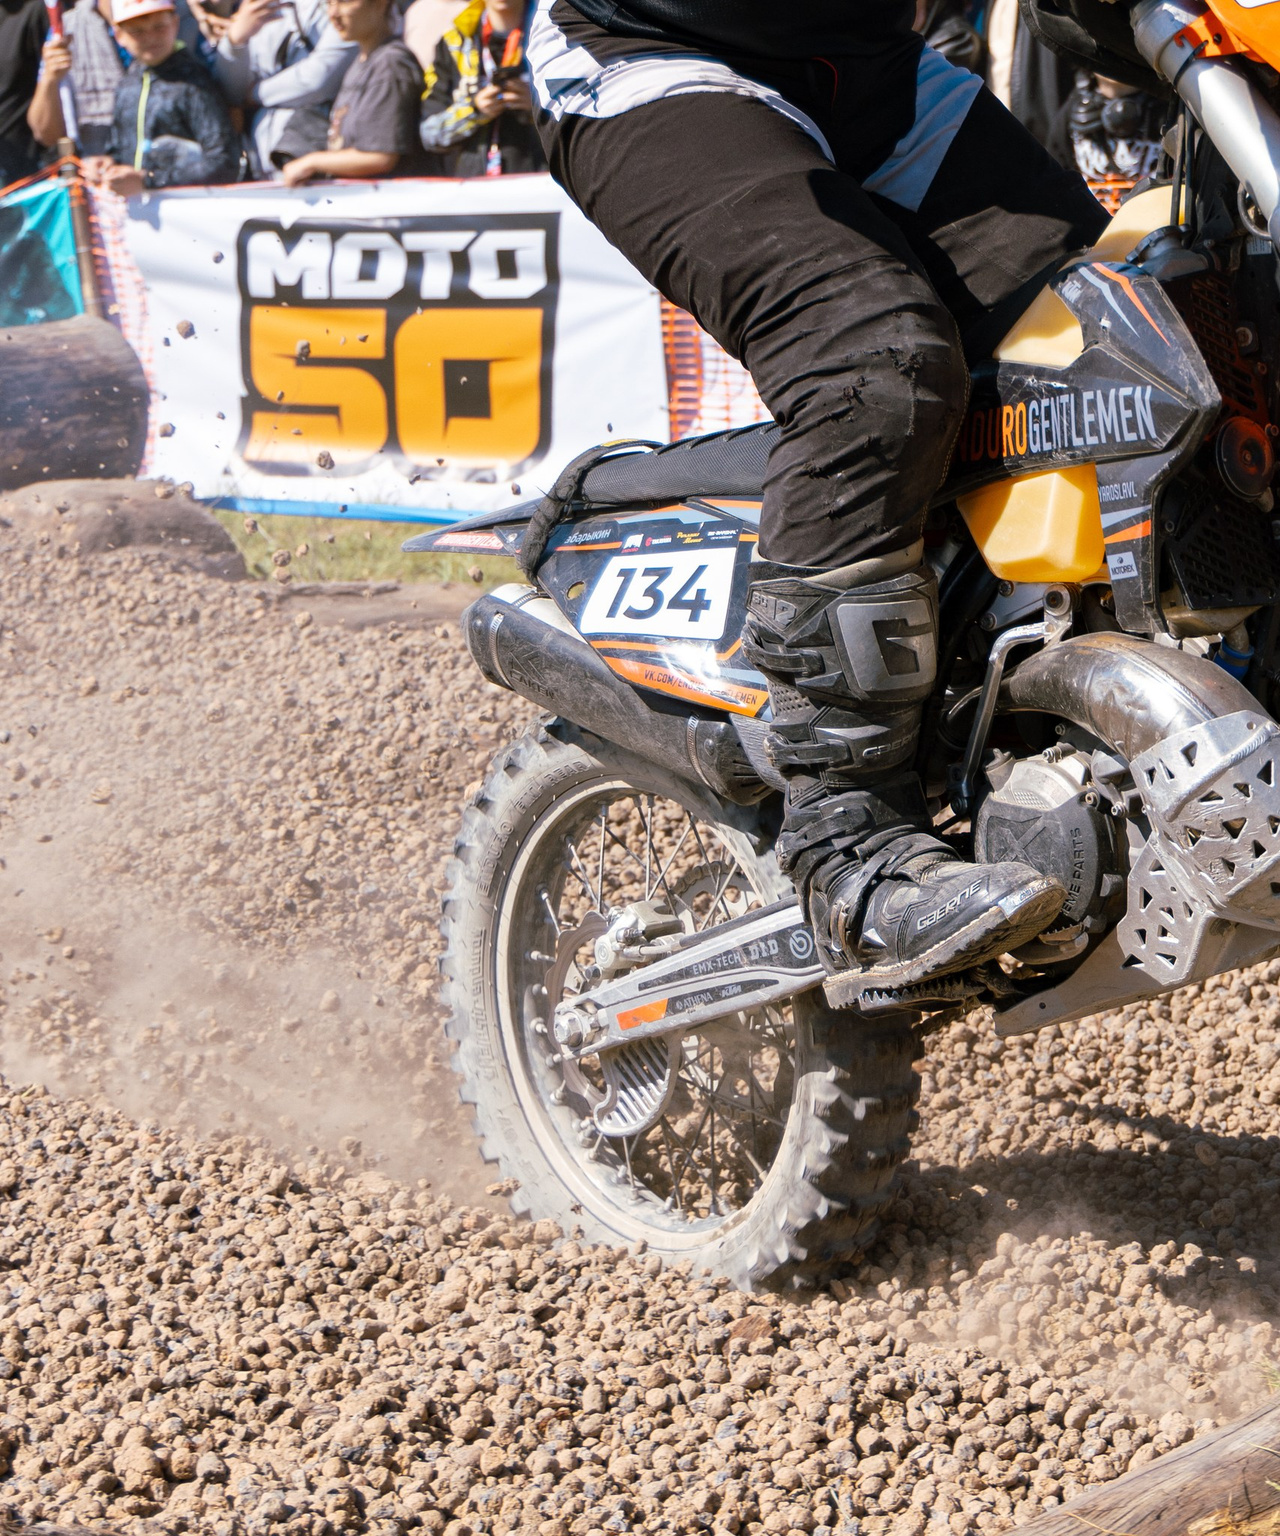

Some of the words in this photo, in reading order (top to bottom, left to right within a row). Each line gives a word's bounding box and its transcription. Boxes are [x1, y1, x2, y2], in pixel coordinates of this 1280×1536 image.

[246, 228, 547, 300] MOTO
[245, 305, 545, 467] 50
[604, 564, 711, 625] 134
[692, 951, 742, 975] EMX-TECH
